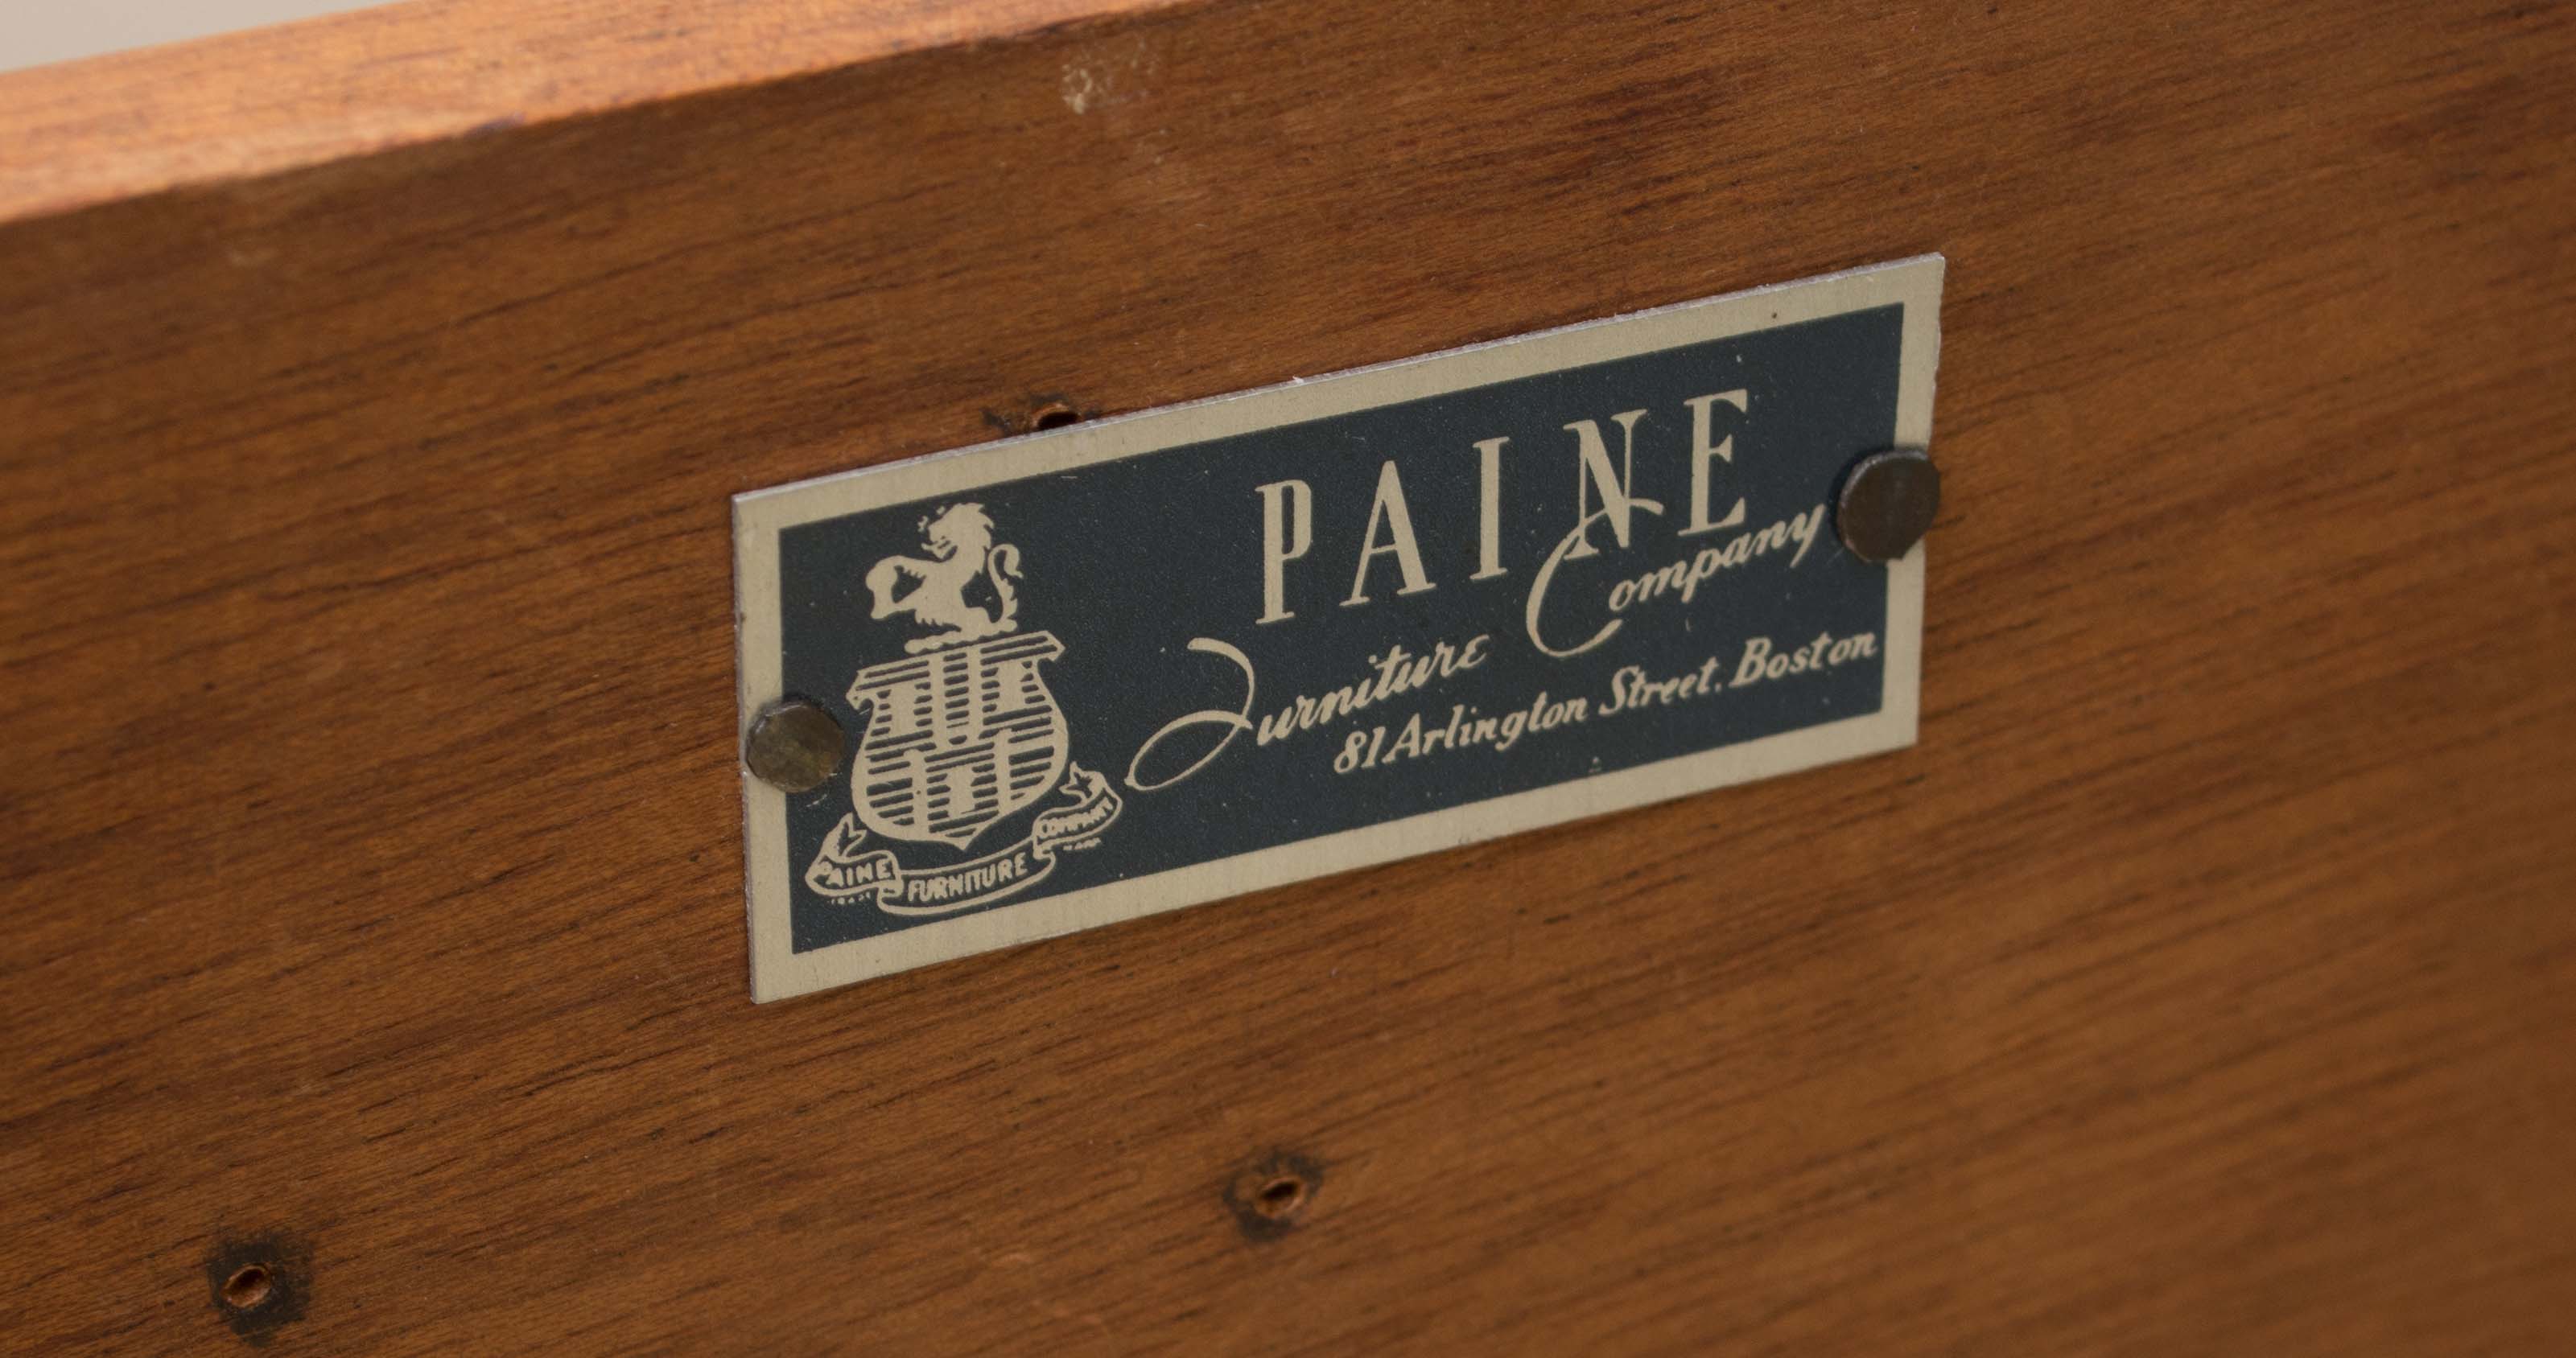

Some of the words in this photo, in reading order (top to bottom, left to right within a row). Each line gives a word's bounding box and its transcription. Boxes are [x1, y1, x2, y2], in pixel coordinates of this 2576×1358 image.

[1255, 389, 1748, 624] PAINE
[1123, 633, 1491, 792] Furniture
[1526, 497, 1825, 658] Company
[1333, 726, 1387, 775] 81
[1381, 690, 1589, 765] Arlington
[1728, 632, 1877, 688] Boston
[907, 851, 1029, 902] FURNITURE
